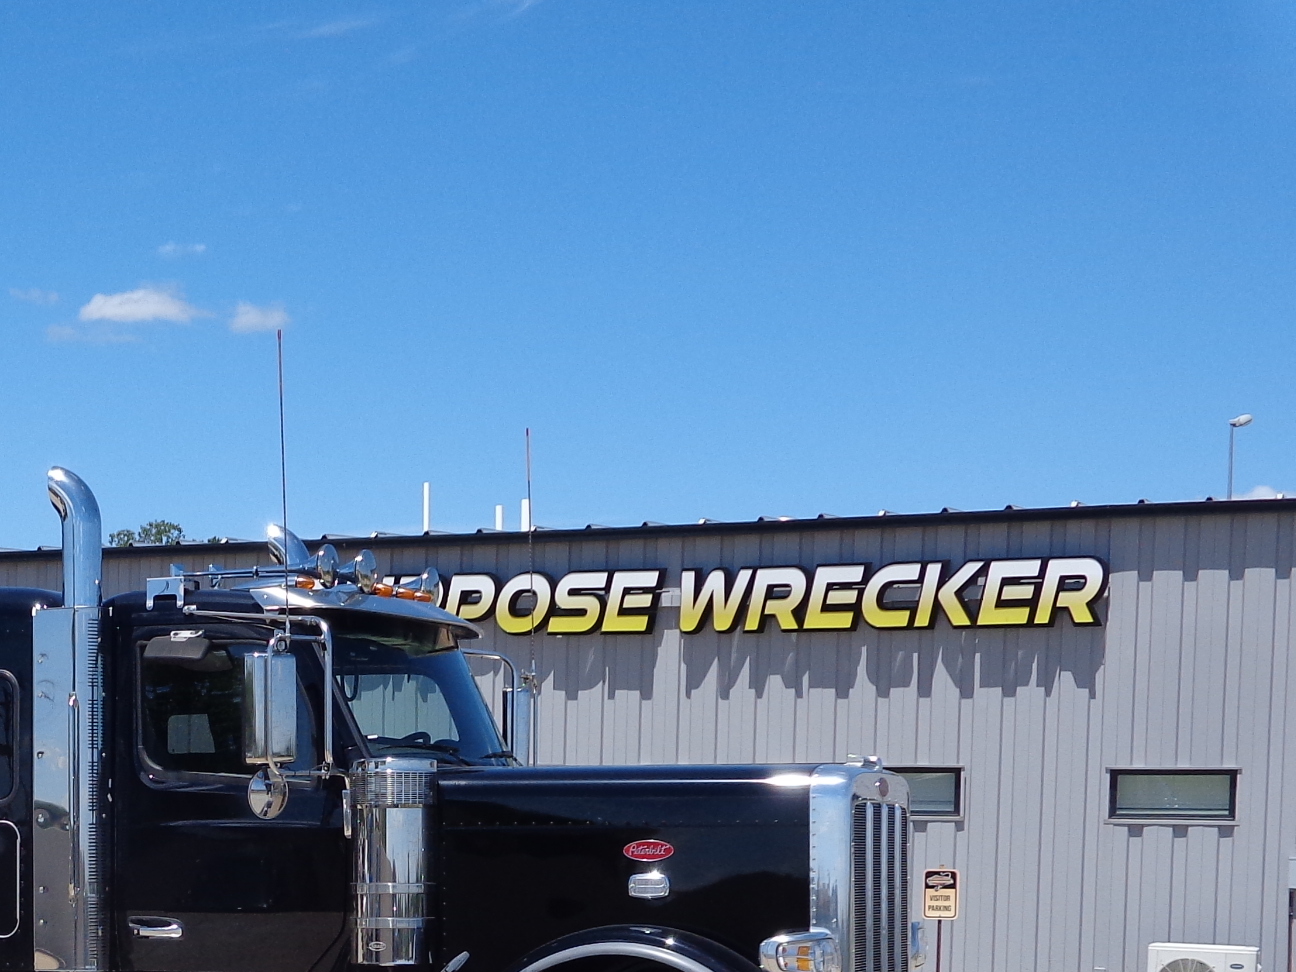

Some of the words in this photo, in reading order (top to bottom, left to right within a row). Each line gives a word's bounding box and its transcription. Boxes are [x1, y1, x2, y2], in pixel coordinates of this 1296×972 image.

[382, 571, 659, 634] POSE
[678, 557, 1103, 632] WRECKER
[629, 843, 670, 856] Peterbilt
